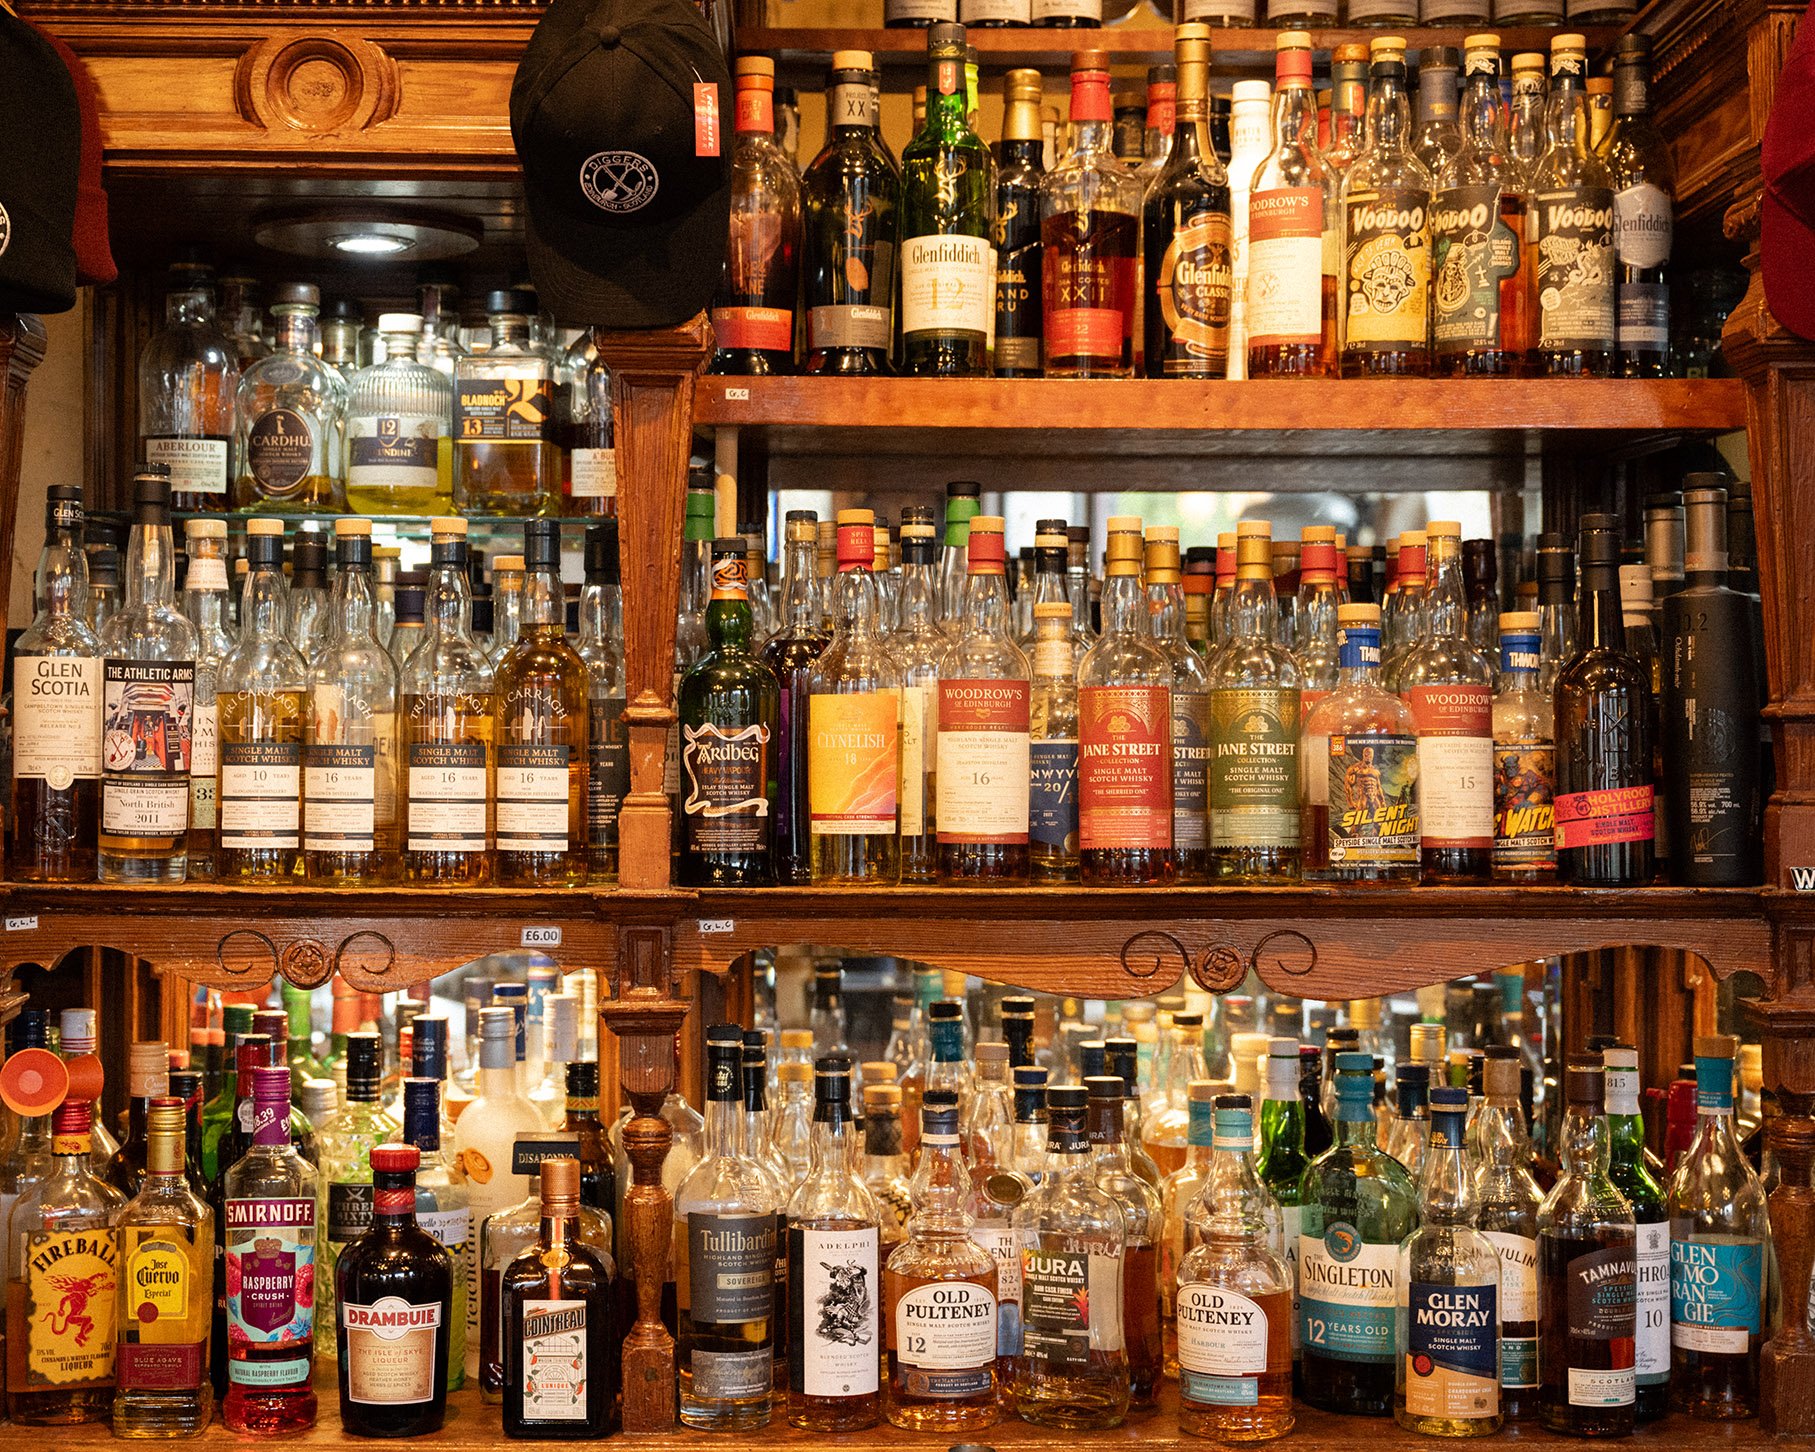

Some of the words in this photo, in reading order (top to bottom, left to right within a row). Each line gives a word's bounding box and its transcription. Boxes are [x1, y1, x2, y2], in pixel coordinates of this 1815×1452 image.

[588, 156, 649, 172] DIGGERS
[584, 182, 618, 210] EDINBURGH
[622, 185, 654, 210] SCOTLAND
[1250, 196, 1308, 210] OODROW'S
[1354, 206, 1423, 235] VOODOO
[1436, 203, 1488, 233] OODOO
[1549, 204, 1613, 233] VOODOO
[1614, 214, 1670, 232] Glenfiddich
[912, 243, 980, 264] Glenfiddich
[1177, 260, 1232, 286] Glenfidd
[928, 278, 965, 310] 12
[1061, 286, 1104, 302] XXII
[746, 310, 780, 321] Glenfiddich
[851, 308, 882, 320] Glenfiddich
[461, 394, 505, 406] BLADNOCH
[380, 420, 396, 436] 12
[462, 419, 483, 435] 13
[156, 441, 216, 452] ABERLOUR
[252, 436, 309, 447] CARDHU
[54, 508, 73, 518] GLEN
[38, 660, 82, 678] GLEN
[108, 667, 122, 679] THE
[124, 668, 170, 680] ATHLETIC
[172, 668, 193, 681] ARMS
[32, 678, 90, 696] SCOTIA
[945, 688, 1022, 700] WOODROW'S
[238, 686, 298, 719] CARRAGH
[426, 686, 486, 719] CARRAGH
[507, 688, 568, 720] CARRAGH
[817, 733, 885, 748] CLYNELISH
[1333, 744, 1342, 752] 386
[454, 748, 478, 756] MALT
[1084, 744, 1109, 757] JANE
[1112, 744, 1161, 756] STREET
[1174, 747, 1210, 759] STREET
[1218, 744, 1248, 757] JANE
[1250, 743, 1295, 755] STREET
[845, 753, 857, 765] 18
[253, 770, 267, 781] 10
[325, 772, 338, 783] 16
[441, 773, 456, 783] 16
[520, 773, 534, 783] 16
[972, 772, 990, 785] 16
[1460, 776, 1475, 789] 15
[1588, 787, 1650, 804] HOLYROOD
[120, 800, 144, 808] North
[147, 800, 175, 808] British
[1589, 799, 1651, 816] DISTILLERY
[135, 814, 160, 823] 2011
[1342, 804, 1408, 827] SILENT
[1507, 806, 1554, 838] WATCH
[1380, 816, 1419, 836] NIGHT
[1595, 820, 1616, 828] SINGLE
[1336, 839, 1360, 847] SPEYSIDE
[1527, 838, 1548, 846] SCOTCH
[525, 930, 557, 941] £6.00
[1069, 1142, 1089, 1150] JURA
[701, 1228, 776, 1252] Tullibardin
[818, 1241, 870, 1249] ADELPHI
[32, 1238, 115, 1272] FIREBALL
[1671, 1243, 1716, 1266] GLEN
[151, 1259, 167, 1270] Jose
[1025, 1257, 1084, 1276] JURA
[1304, 1256, 1394, 1288] SINGLETON
[1579, 1260, 1637, 1284] TAMNAVU
[137, 1267, 179, 1287] Cuervo
[243, 1275, 293, 1289] RASPBERRY
[1684, 1267, 1719, 1285] MO
[144, 1290, 171, 1299] Especial
[933, 1290, 970, 1303] OLD
[1192, 1293, 1224, 1308] OLD
[1672, 1283, 1706, 1302] RAN
[1428, 1293, 1479, 1310] GLEN
[348, 1309, 434, 1327] DRAMBUIE
[906, 1302, 991, 1319] PULTENEY
[1178, 1304, 1254, 1325] PULTENEY
[1416, 1309, 1490, 1328] MORAY
[1645, 1309, 1663, 1328] 10
[1684, 1303, 1714, 1323] GIE
[524, 1308, 585, 1337] COINTREAU
[1328, 1322, 1361, 1333] YEARS
[1365, 1325, 1389, 1335] OLD
[1308, 1318, 1326, 1344] 12
[907, 1336, 926, 1353] 12
[1191, 1338, 1226, 1349] HARBOUR
[60, 1361, 93, 1371] LIQUEUR
[252, 1368, 279, 1376] RASPBERRY
[280, 1367, 298, 1376] FLAVOUR
